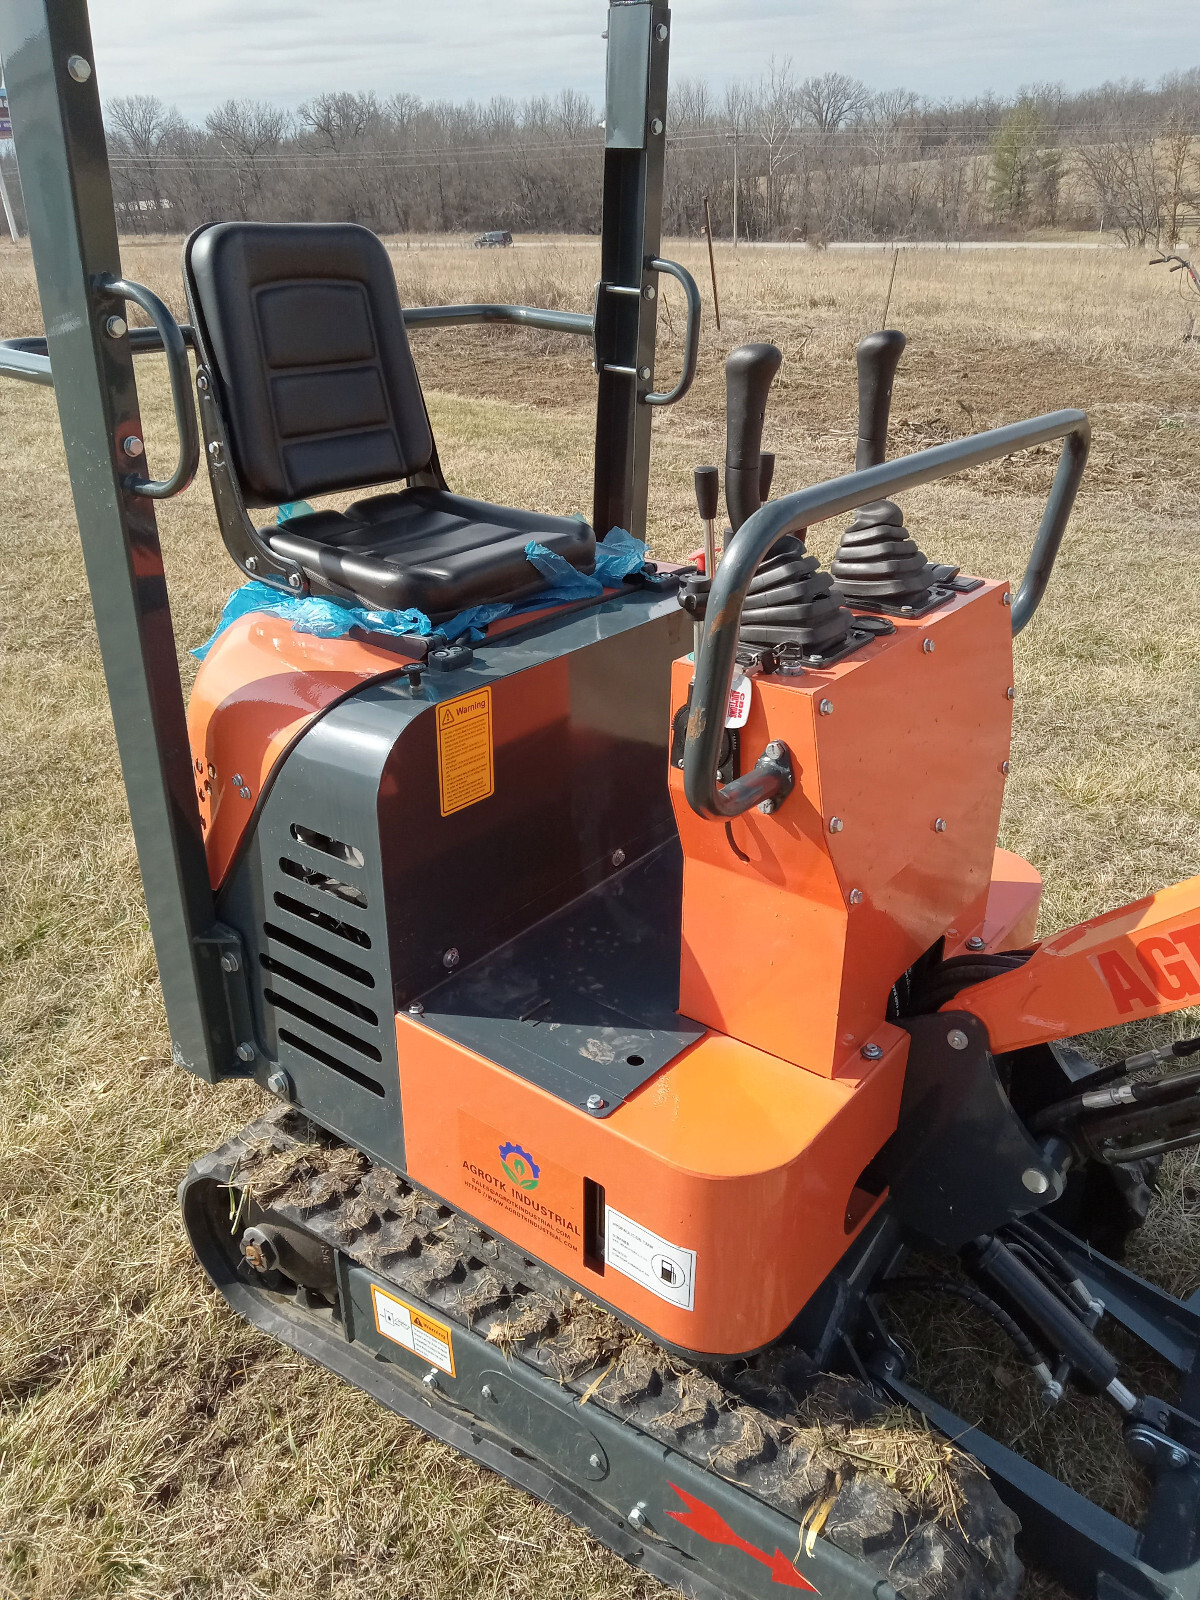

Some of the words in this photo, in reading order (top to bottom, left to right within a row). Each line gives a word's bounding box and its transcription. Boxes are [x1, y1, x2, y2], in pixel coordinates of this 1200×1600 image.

[456, 700, 486, 716] Warning
[462, 1160, 507, 1192] AGROTK
[511, 1188, 581, 1237] INDUSTRIAL
